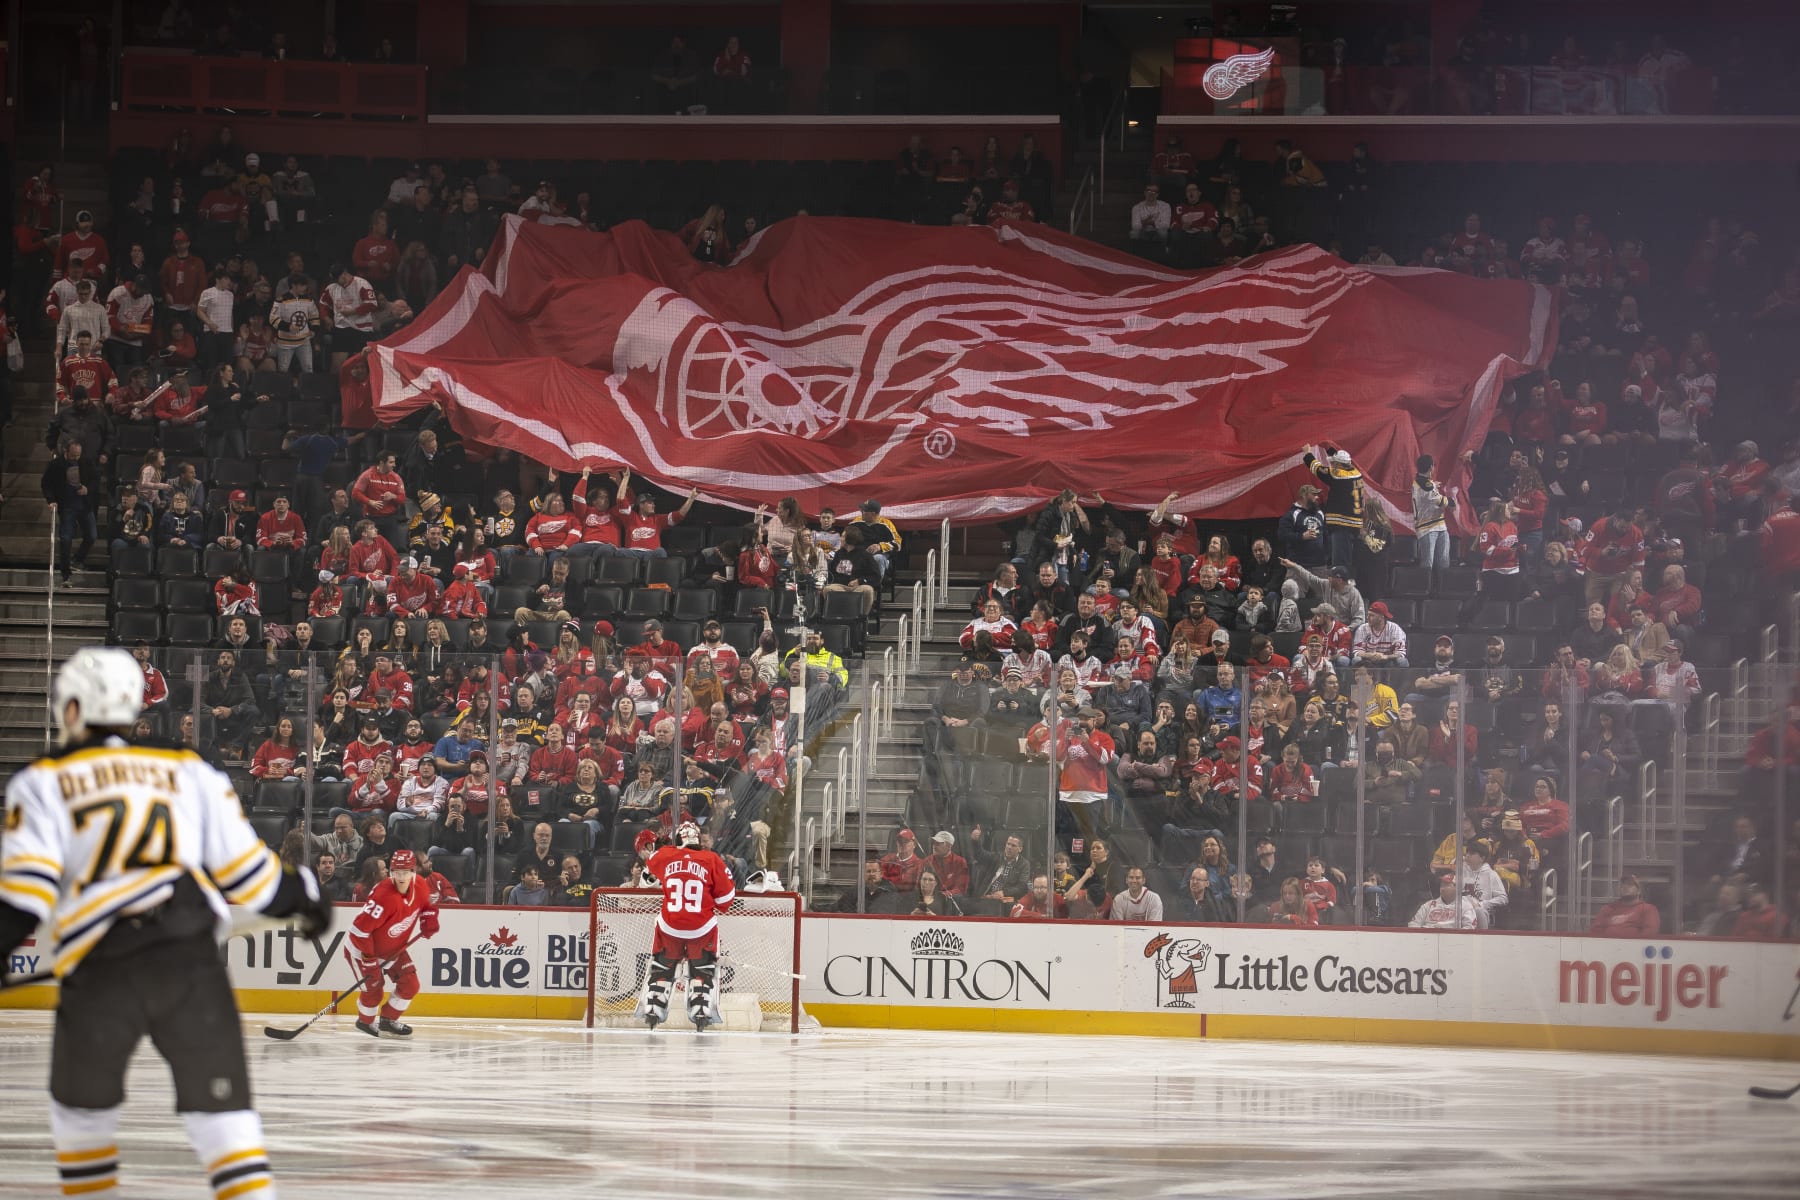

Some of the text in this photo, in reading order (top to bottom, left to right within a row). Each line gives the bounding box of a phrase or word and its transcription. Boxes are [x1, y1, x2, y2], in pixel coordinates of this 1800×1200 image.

[72, 796, 178, 896] 74
[363, 900, 384, 919] 28
[666, 878, 704, 913] 39
[219, 919, 346, 985] nity
[432, 947, 530, 988] Blue
[475, 943, 525, 956] Labatt
[823, 954, 1053, 1002] CINTRON
[1214, 953, 1448, 996] Little Caesars
[1559, 945, 1728, 1022] meijer
